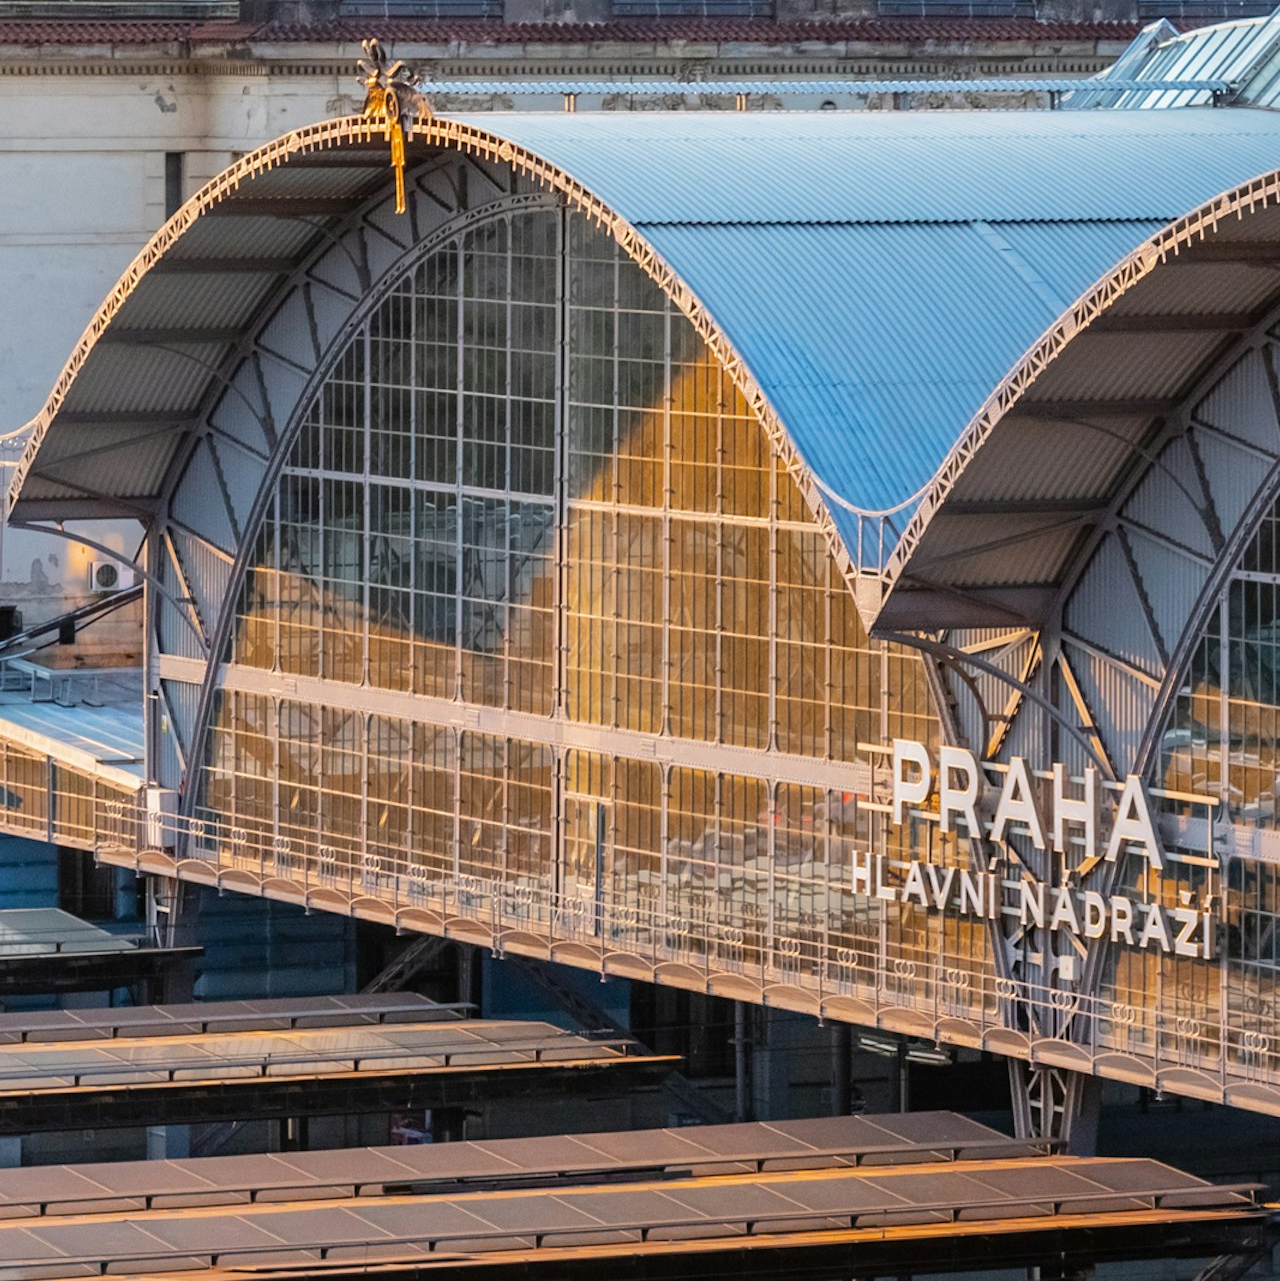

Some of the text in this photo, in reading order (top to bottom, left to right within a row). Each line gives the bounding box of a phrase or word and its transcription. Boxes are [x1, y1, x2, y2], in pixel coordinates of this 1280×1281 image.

[892, 738, 1164, 870] PRAHA
[851, 849, 1214, 960] HLAVNÍ NÁDRAŽÍ
